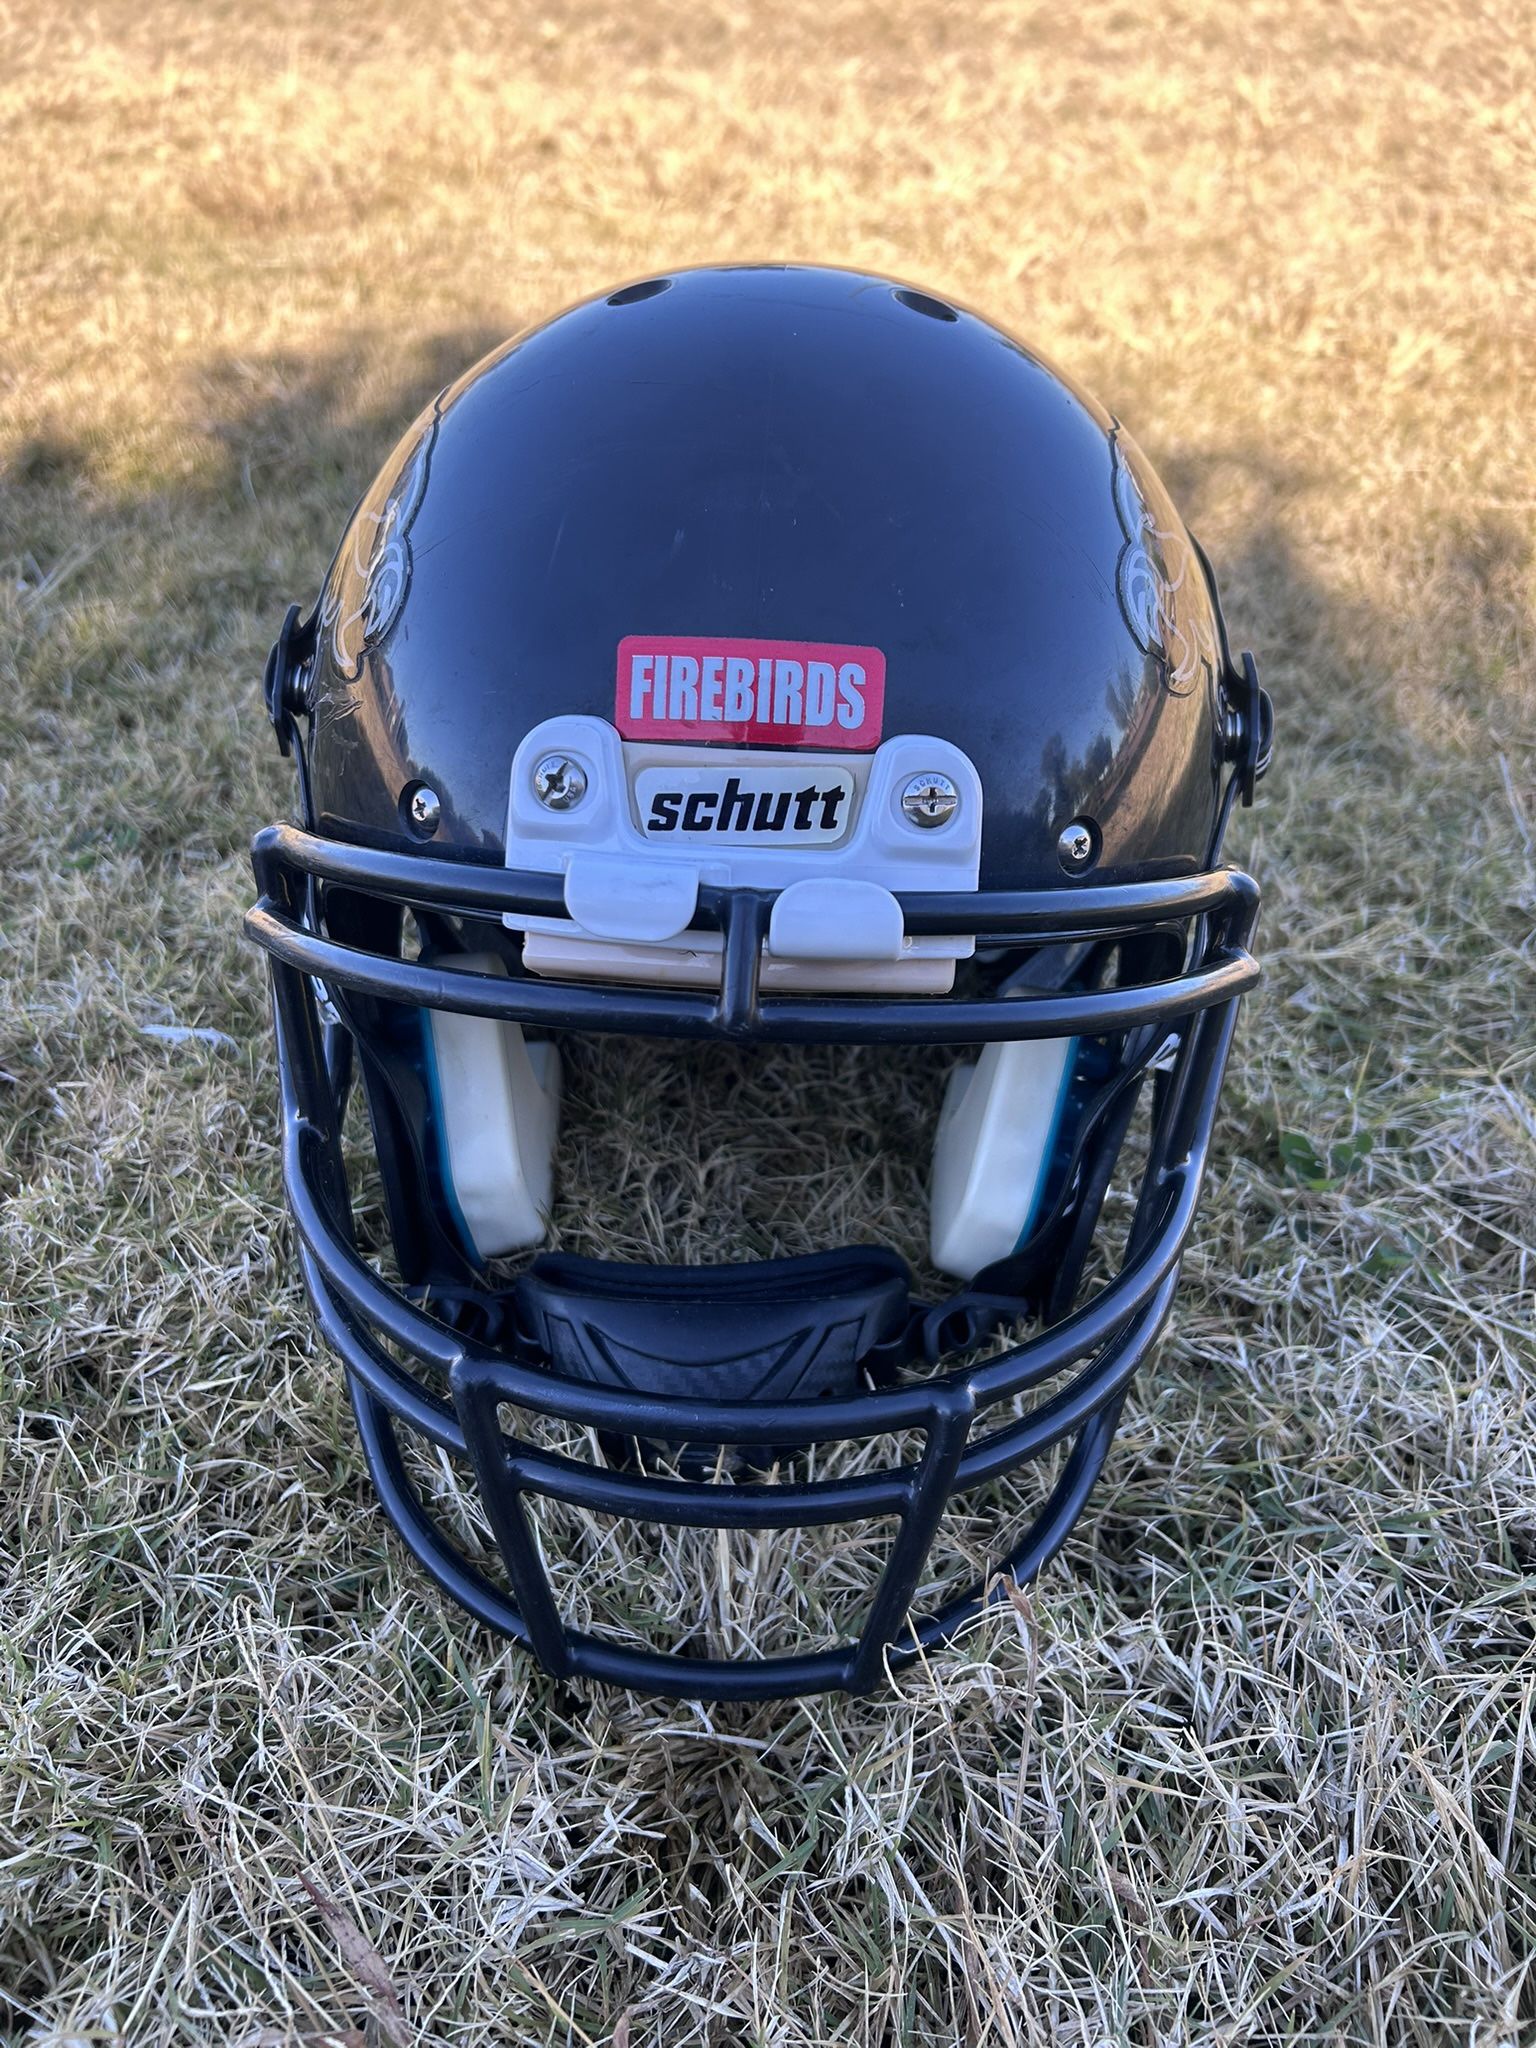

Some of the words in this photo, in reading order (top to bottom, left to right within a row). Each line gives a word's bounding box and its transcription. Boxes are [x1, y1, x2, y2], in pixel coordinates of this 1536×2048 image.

[630, 654, 866, 730] FIREBIRDS
[647, 777, 845, 832] schutt
[913, 778, 951, 792] SCHUTT
